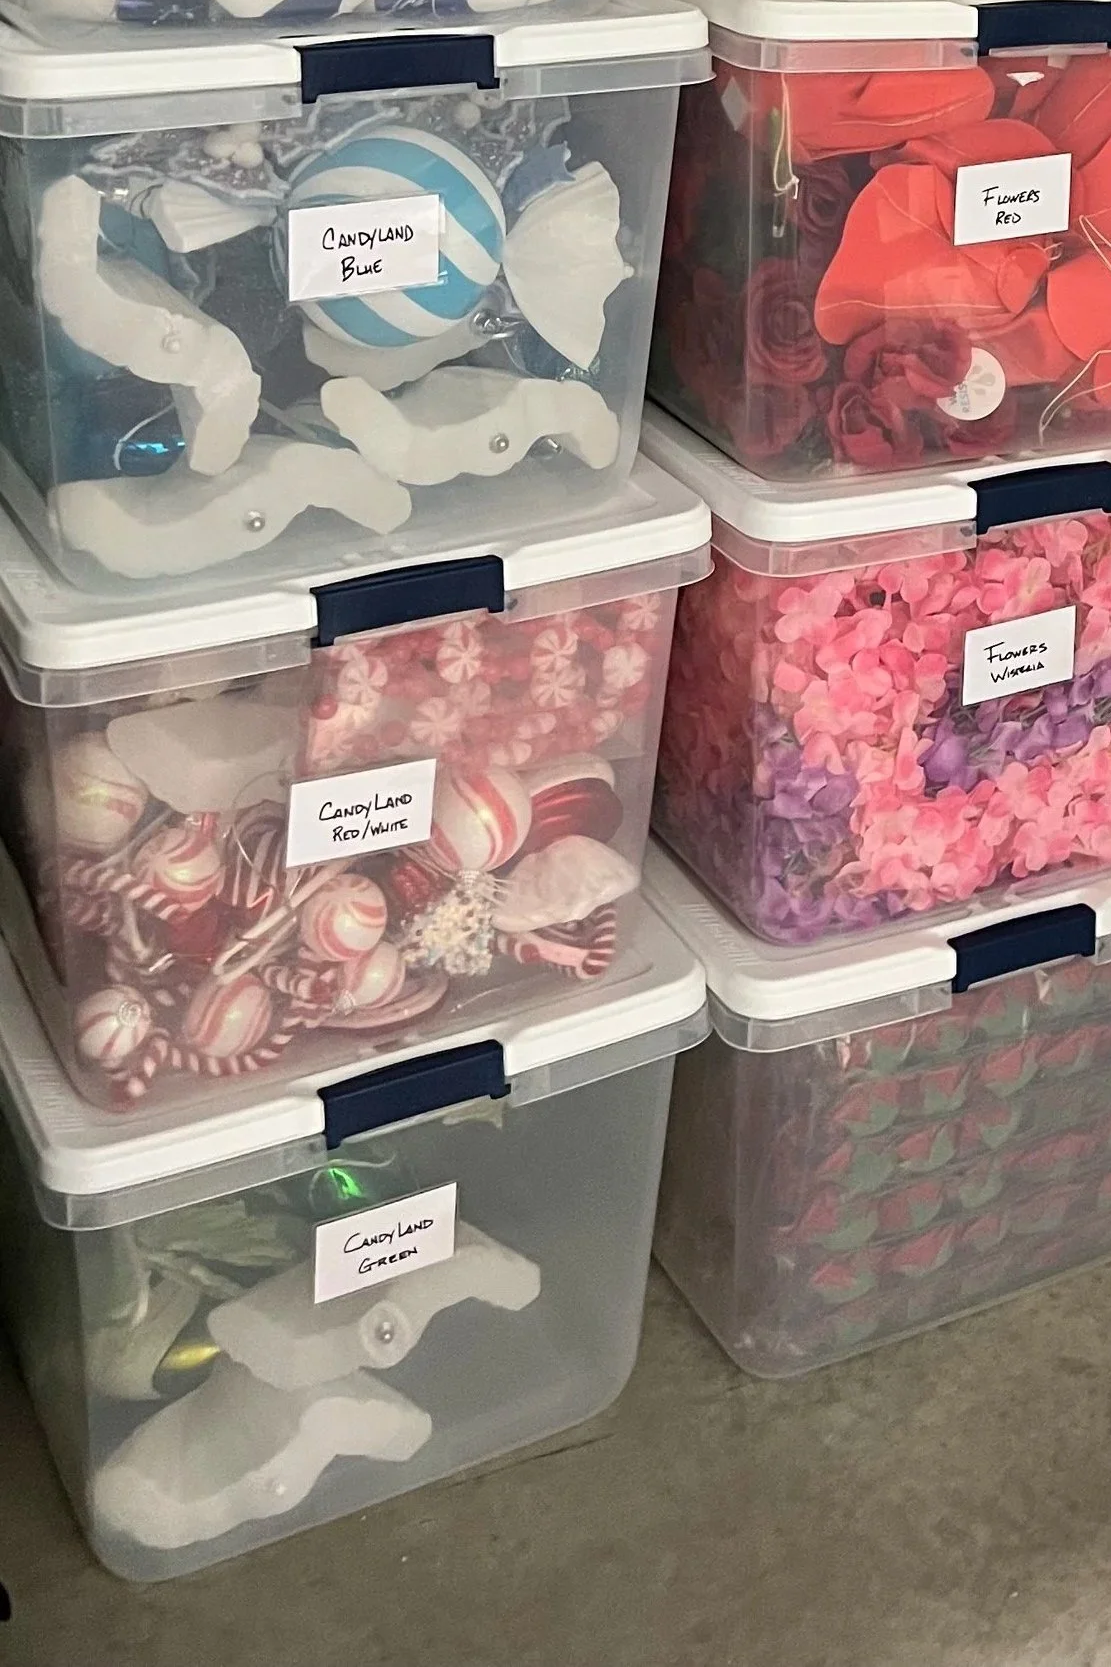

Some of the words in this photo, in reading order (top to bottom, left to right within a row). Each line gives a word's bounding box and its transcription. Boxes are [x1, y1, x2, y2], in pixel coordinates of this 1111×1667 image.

[982, 187, 1041, 205] FLOWERS
[995, 211, 1022, 226] RED
[341, 257, 383, 282] BLUE
[983, 641, 1048, 664] FLOWERS
[358, 1246, 418, 1274] GREEN
